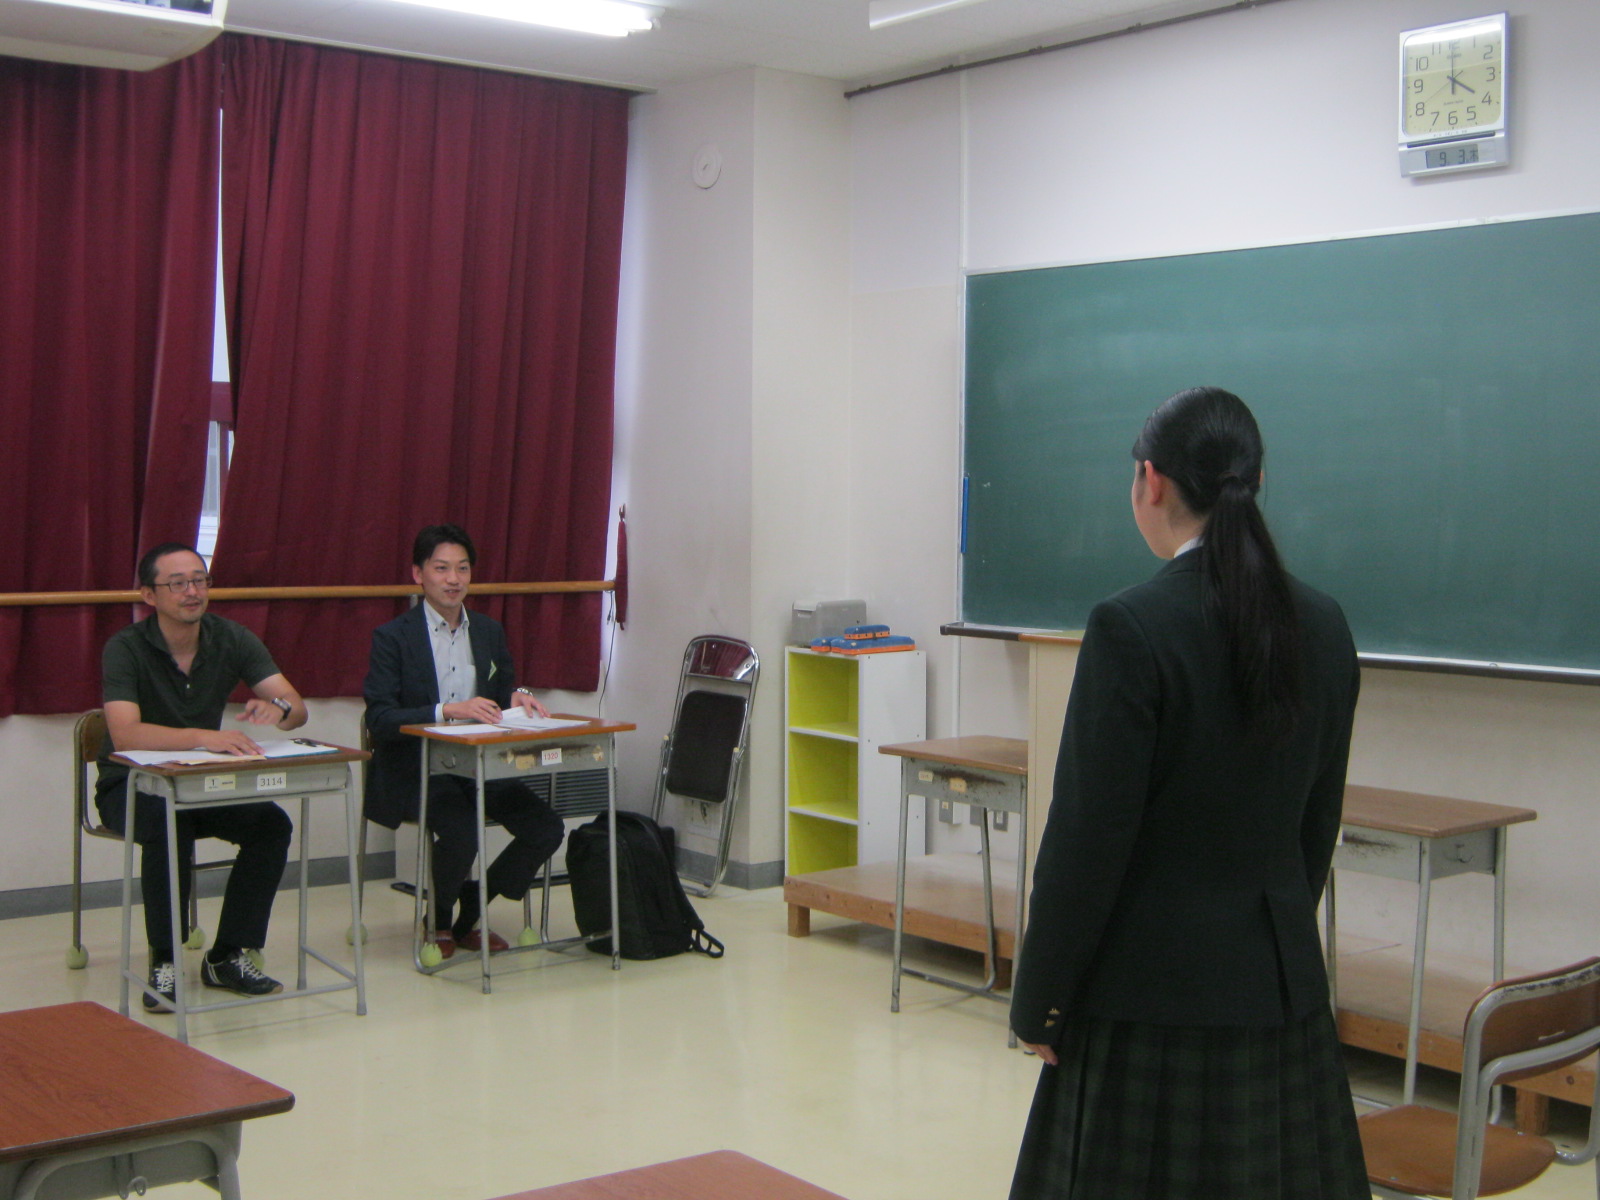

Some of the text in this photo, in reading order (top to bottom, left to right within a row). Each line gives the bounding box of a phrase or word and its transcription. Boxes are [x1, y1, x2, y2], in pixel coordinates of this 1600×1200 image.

[1431, 42, 1441, 56] 11
[1483, 44, 1494, 60] 2
[1415, 56, 1429, 72] 10
[1485, 66, 1496, 82] 3
[1413, 78, 1424, 94] 9
[1481, 91, 1492, 106] 4
[1415, 102, 1425, 117] 8
[1466, 105, 1477, 121] 5
[1430, 111, 1440, 126] 7
[1447, 110, 1458, 126] 6
[1439, 151, 1447, 167] 9
[1458, 149, 1466, 165] 3
[260, 777, 283, 787] 3114
